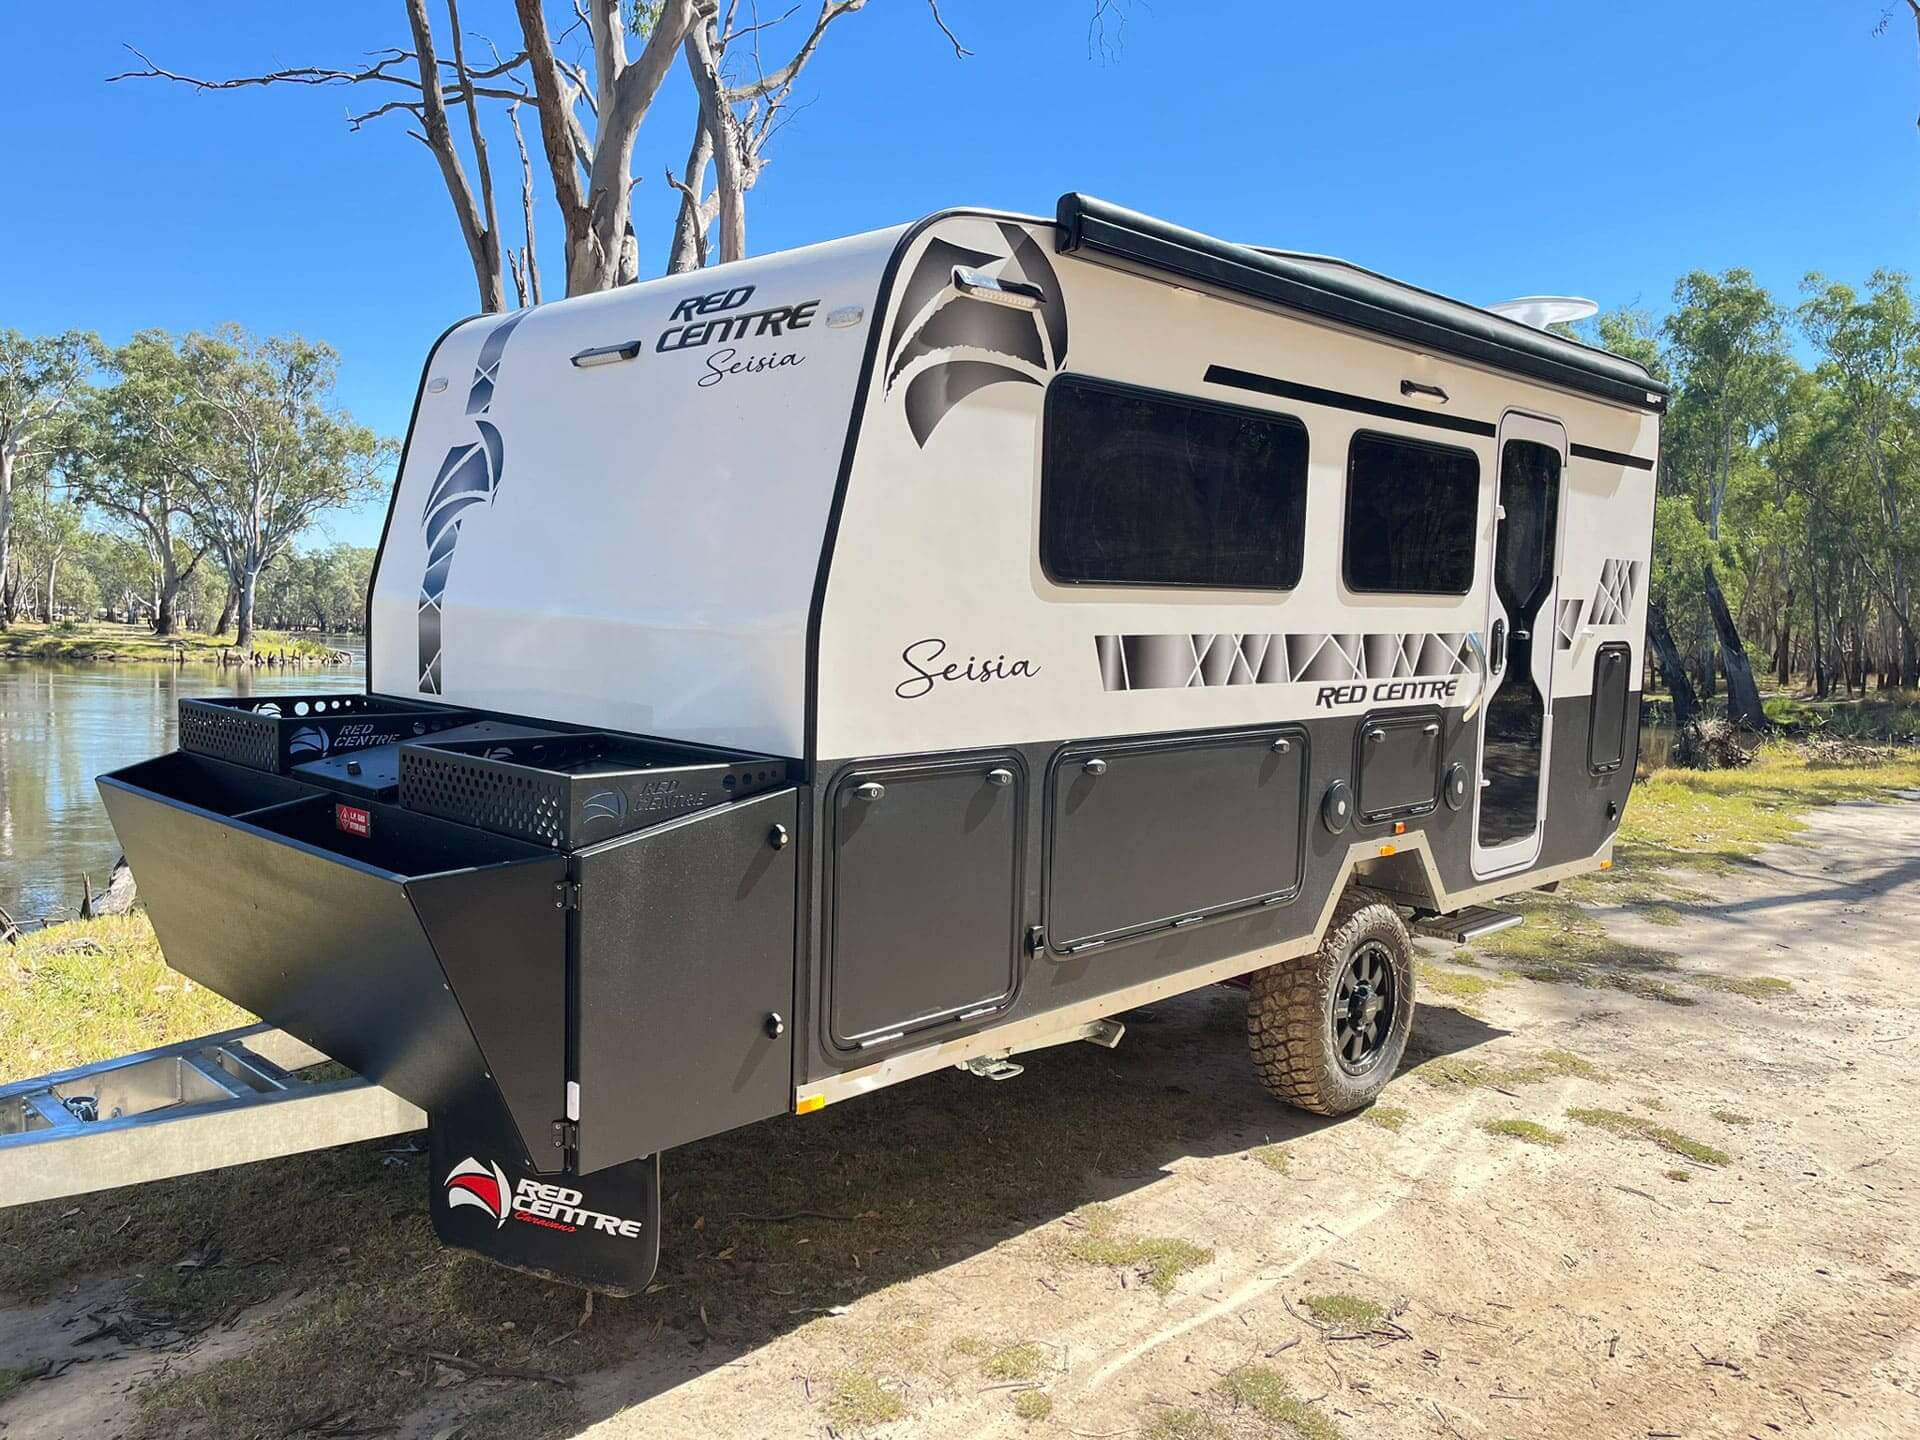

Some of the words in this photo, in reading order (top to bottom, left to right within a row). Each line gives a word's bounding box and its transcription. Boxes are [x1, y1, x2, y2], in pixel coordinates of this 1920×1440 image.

[670, 285, 756, 322] RED
[656, 299, 821, 352] CENTRE
[697, 349, 806, 387] Seisia
[895, 638, 1041, 699] Seisia
[1315, 685, 1367, 709] RED
[1373, 680, 1458, 702] CENTRE
[334, 734, 400, 747] CENTRE
[339, 724, 374, 735] RED
[516, 1178, 583, 1207] RED
[512, 1195, 642, 1238] CENTRE
